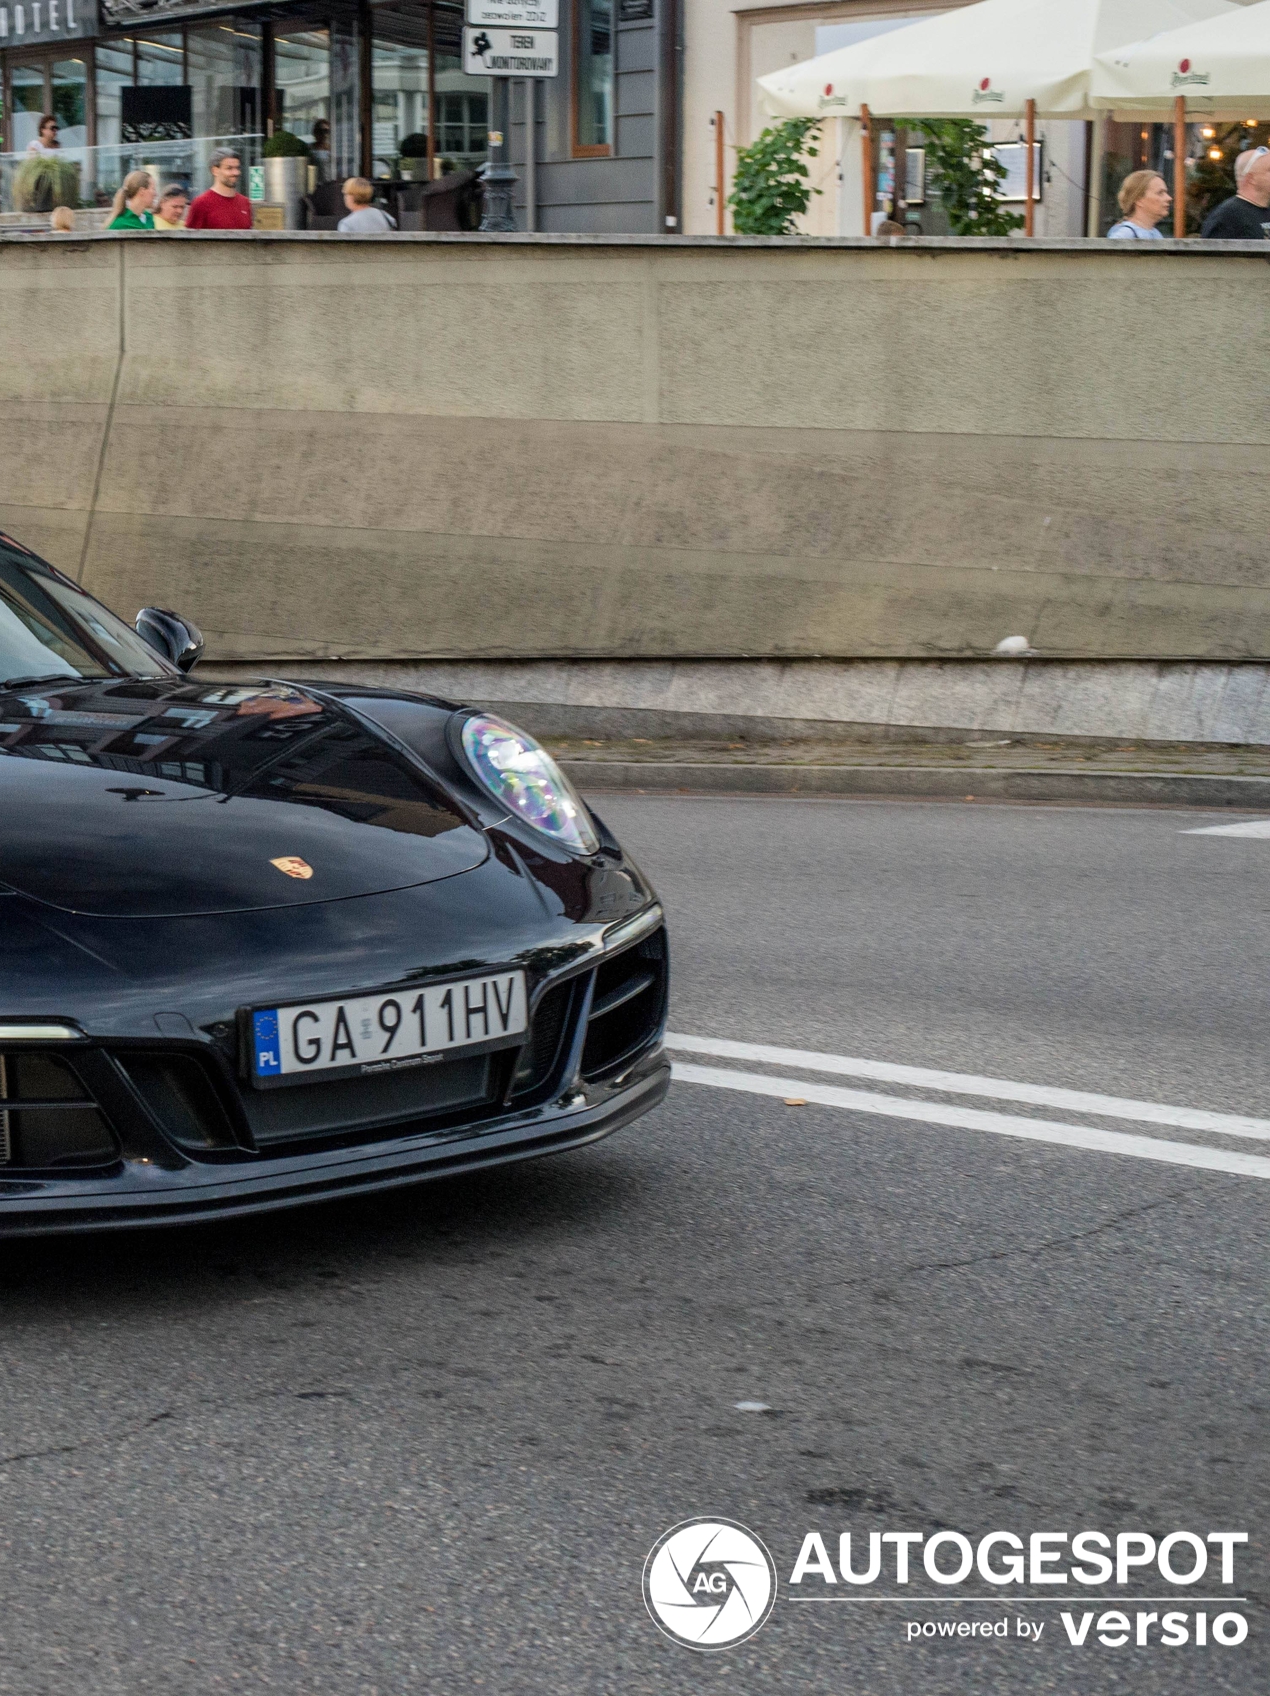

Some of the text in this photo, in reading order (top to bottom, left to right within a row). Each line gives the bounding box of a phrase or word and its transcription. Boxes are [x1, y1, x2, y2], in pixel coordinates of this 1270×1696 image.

[510, 34, 534, 49] TEREN
[292, 976, 515, 1065] GA 911HV
[259, 1051, 279, 1068] PL
